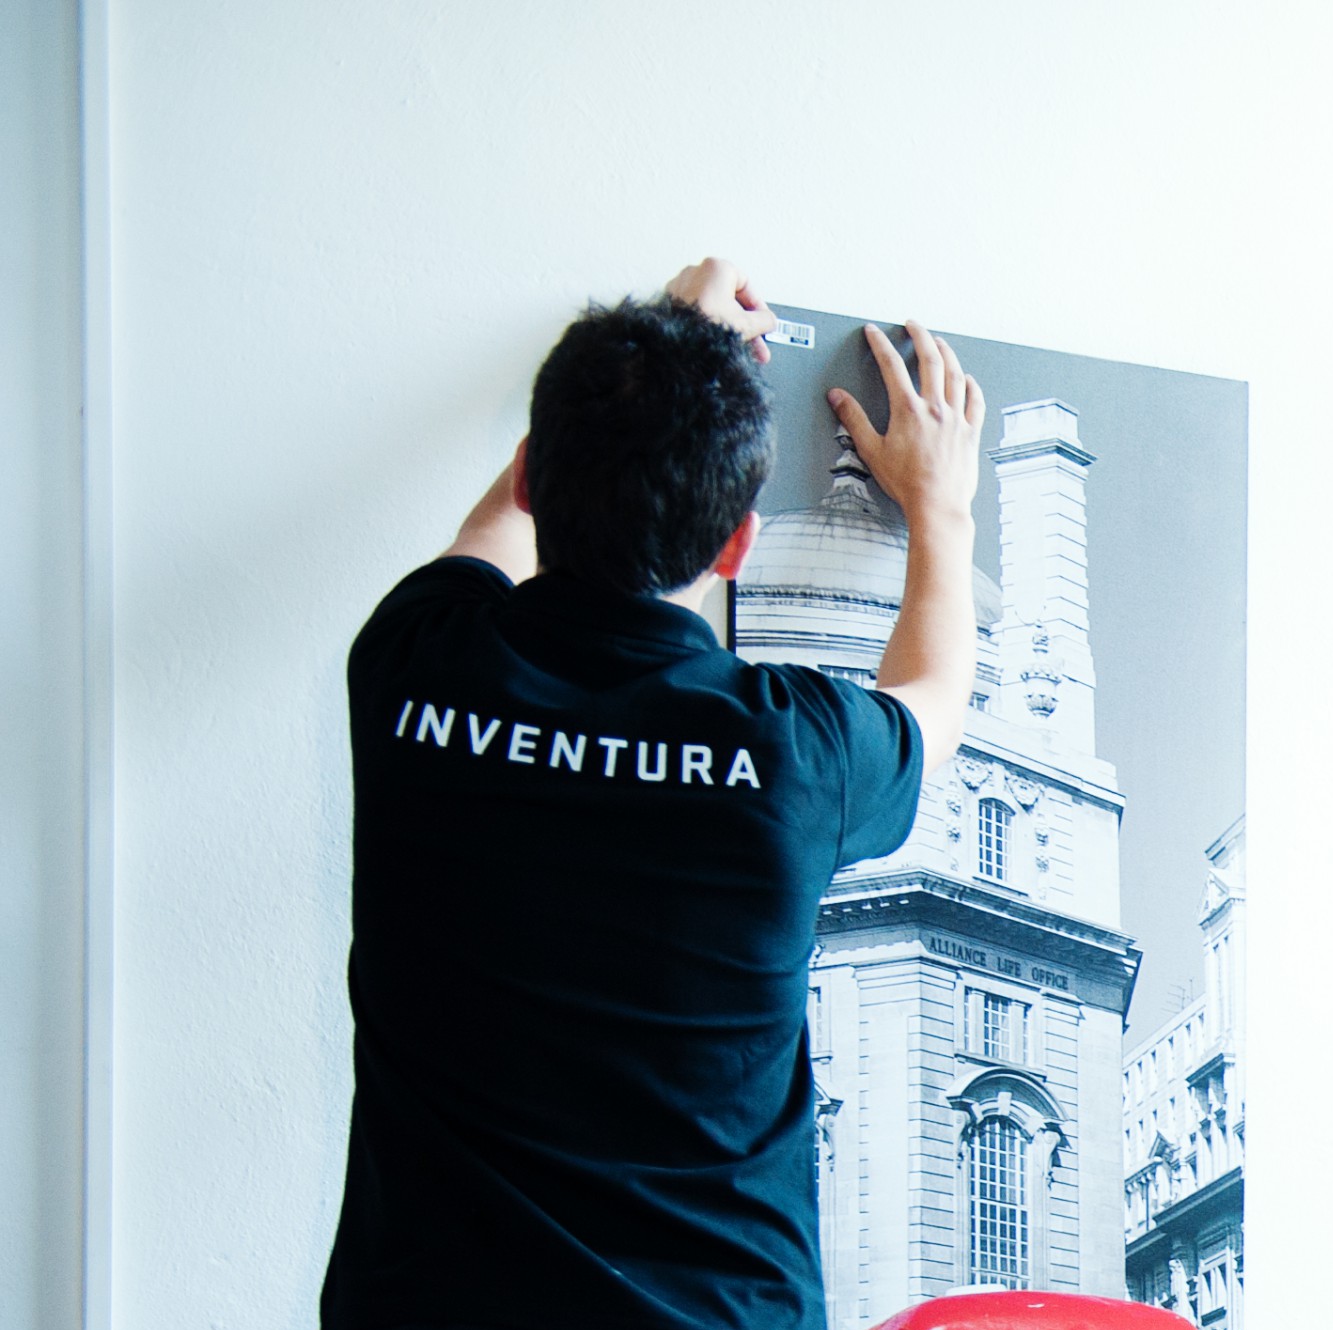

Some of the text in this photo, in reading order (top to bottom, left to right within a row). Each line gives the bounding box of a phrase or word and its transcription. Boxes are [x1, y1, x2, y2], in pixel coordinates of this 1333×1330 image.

[395, 700, 762, 789] INVENTURA
[929, 937, 1069, 991] ALLIANCE LIFE OFFICE
